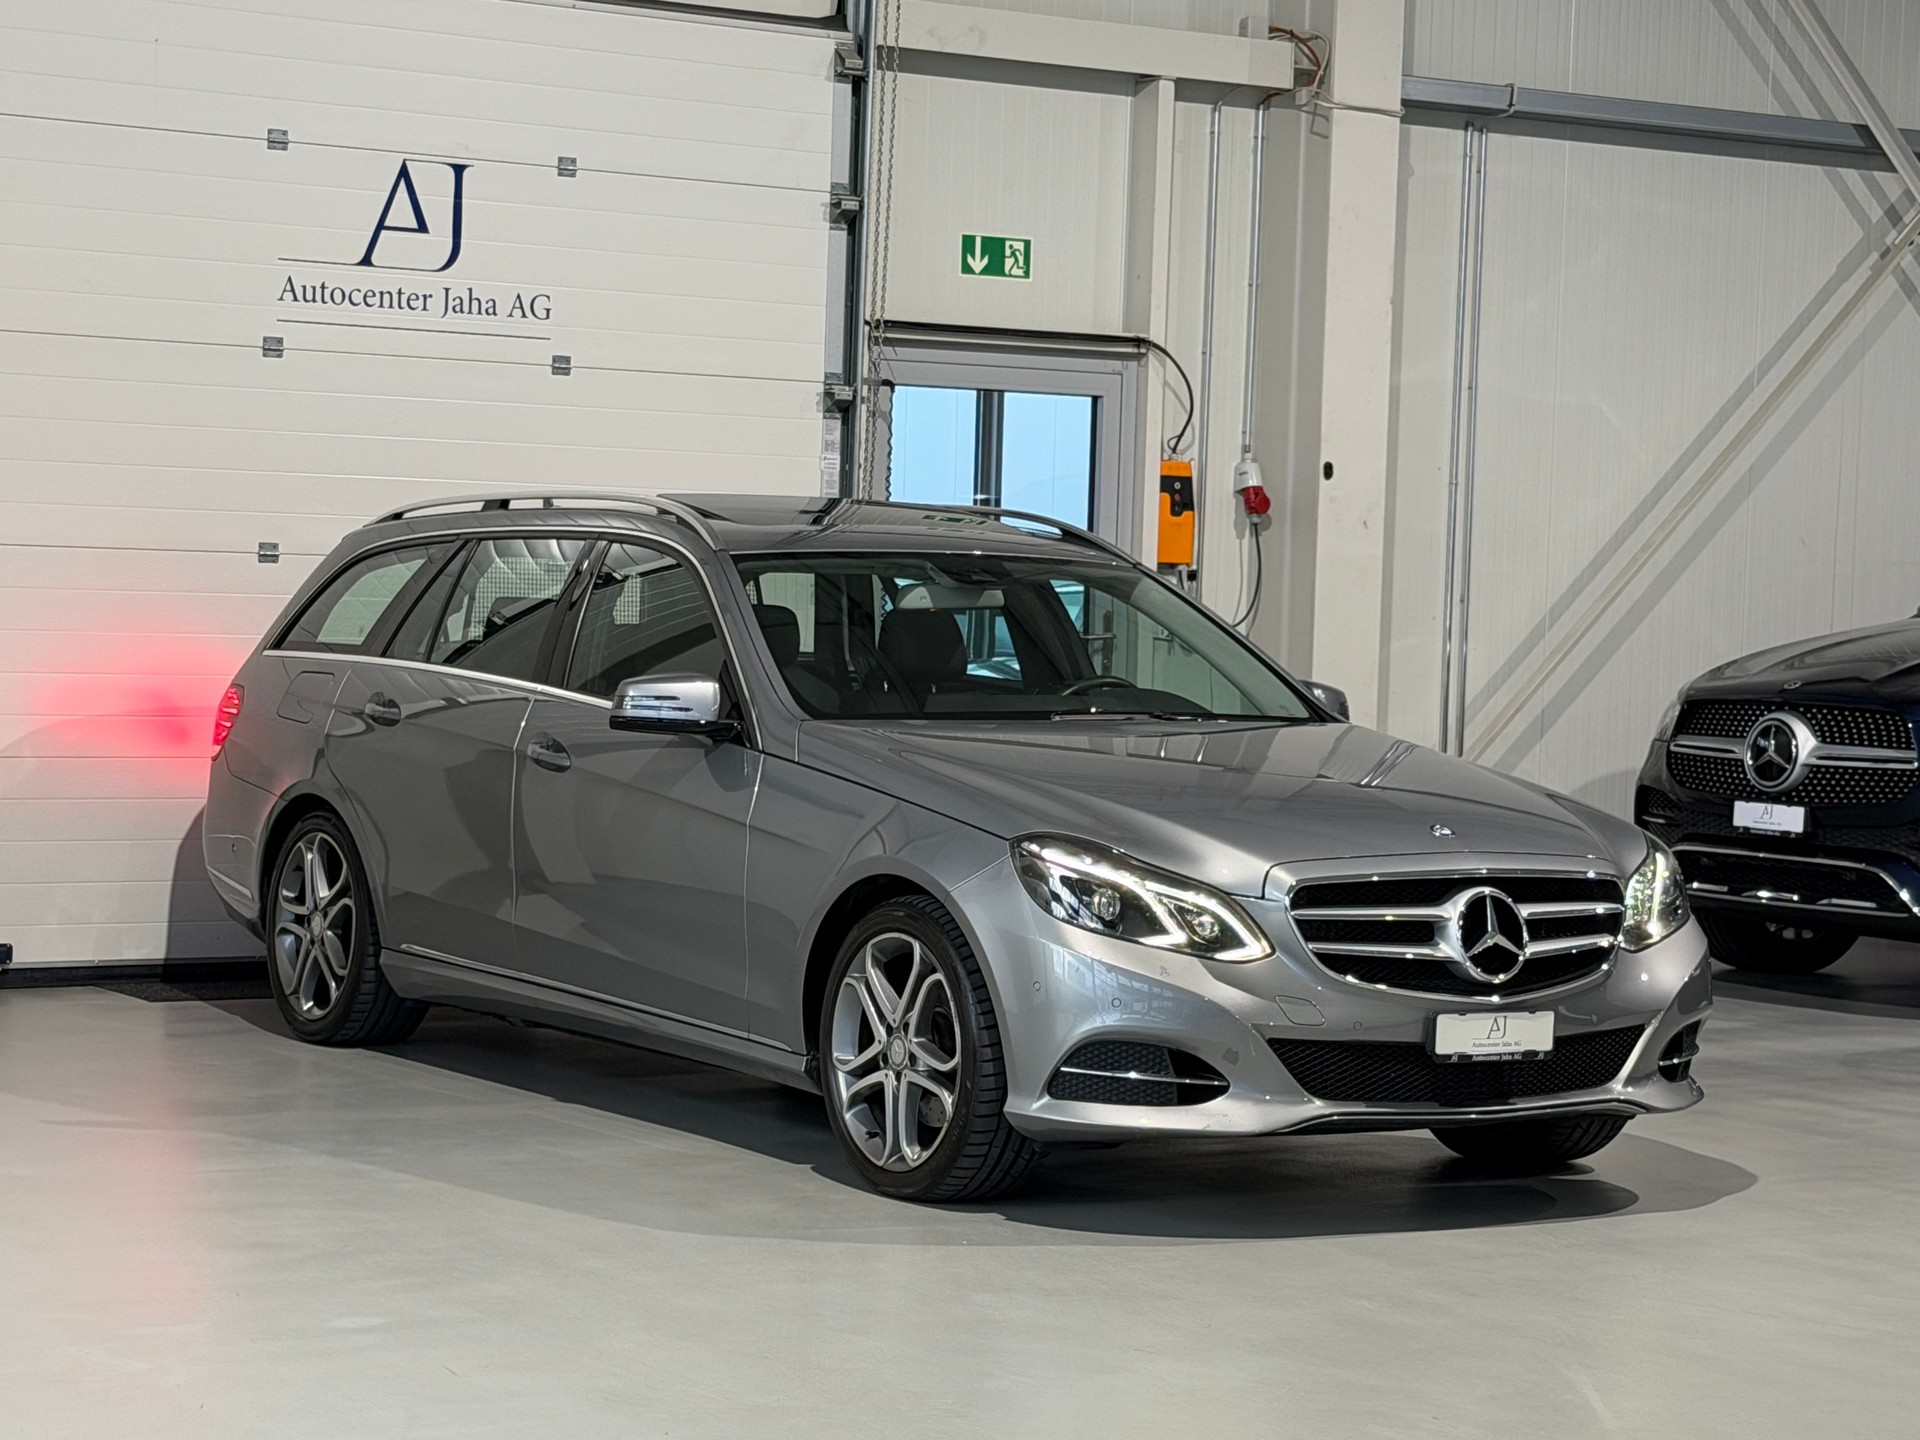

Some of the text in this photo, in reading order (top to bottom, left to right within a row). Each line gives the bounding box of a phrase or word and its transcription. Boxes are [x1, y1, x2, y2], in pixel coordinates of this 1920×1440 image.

[354, 158, 474, 272] AJ
[277, 275, 552, 320] Autocenter Jaha AG
[1486, 1016, 1507, 1039] AJ
